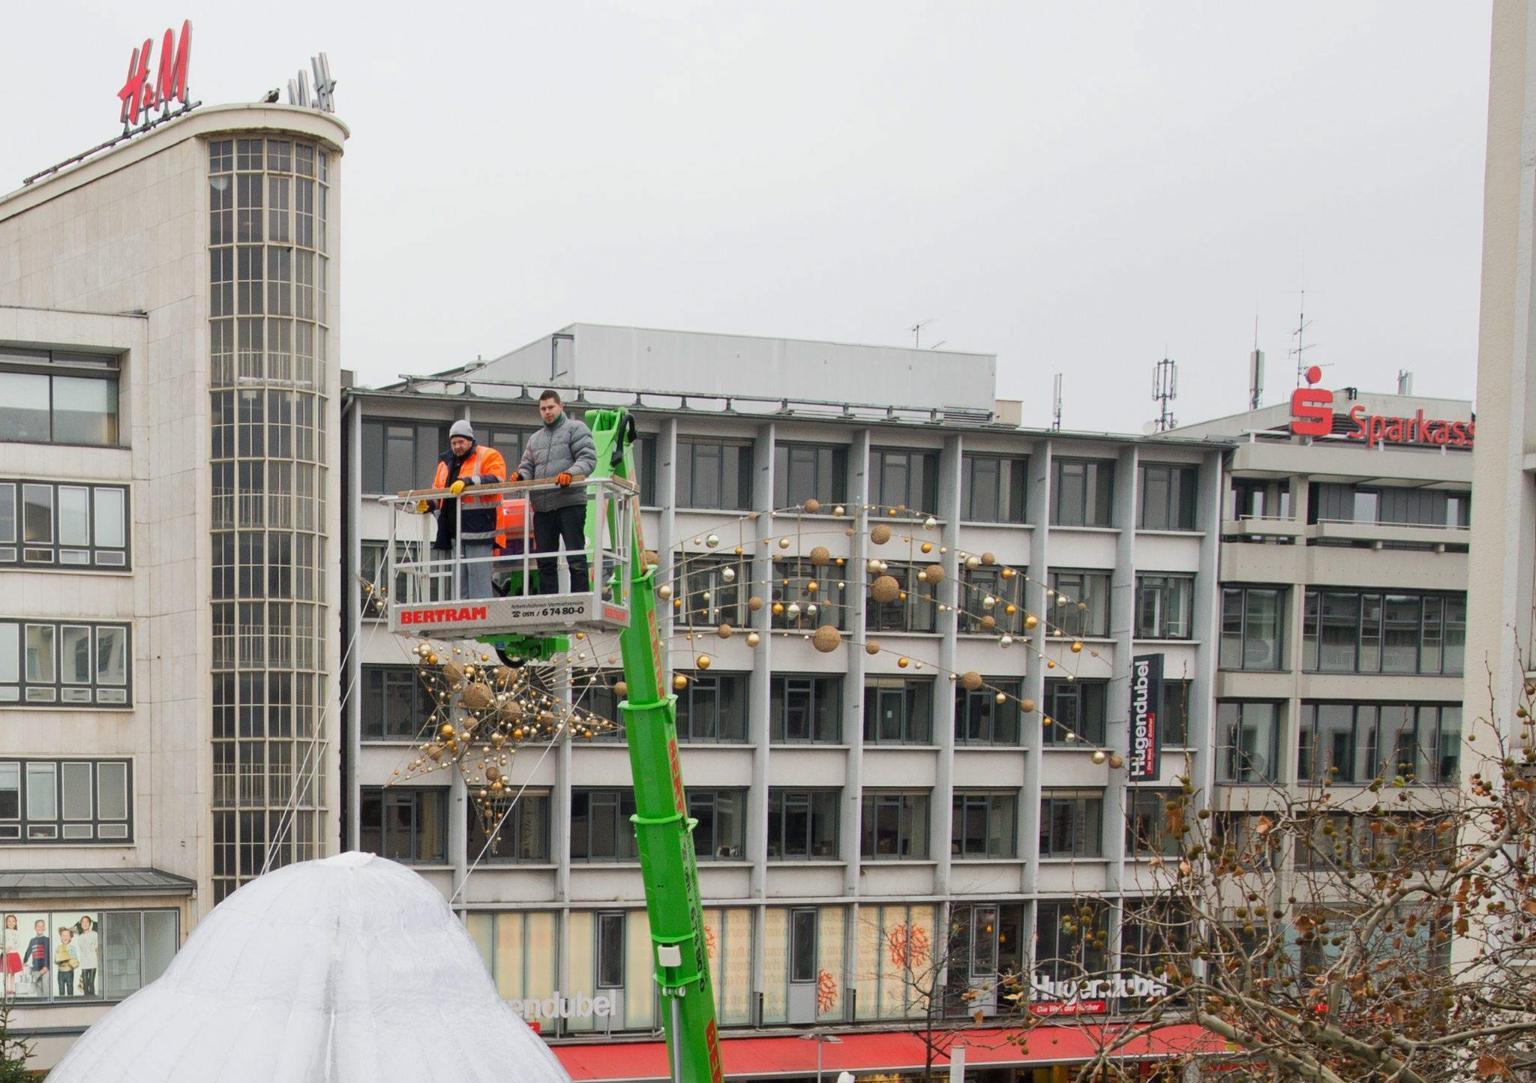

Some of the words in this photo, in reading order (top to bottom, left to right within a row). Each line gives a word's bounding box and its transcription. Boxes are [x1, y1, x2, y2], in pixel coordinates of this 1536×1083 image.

[117, 19, 192, 125] H&M
[400, 606, 487, 624] BERTRAM
[1131, 660, 1149, 776] Hugendubel
